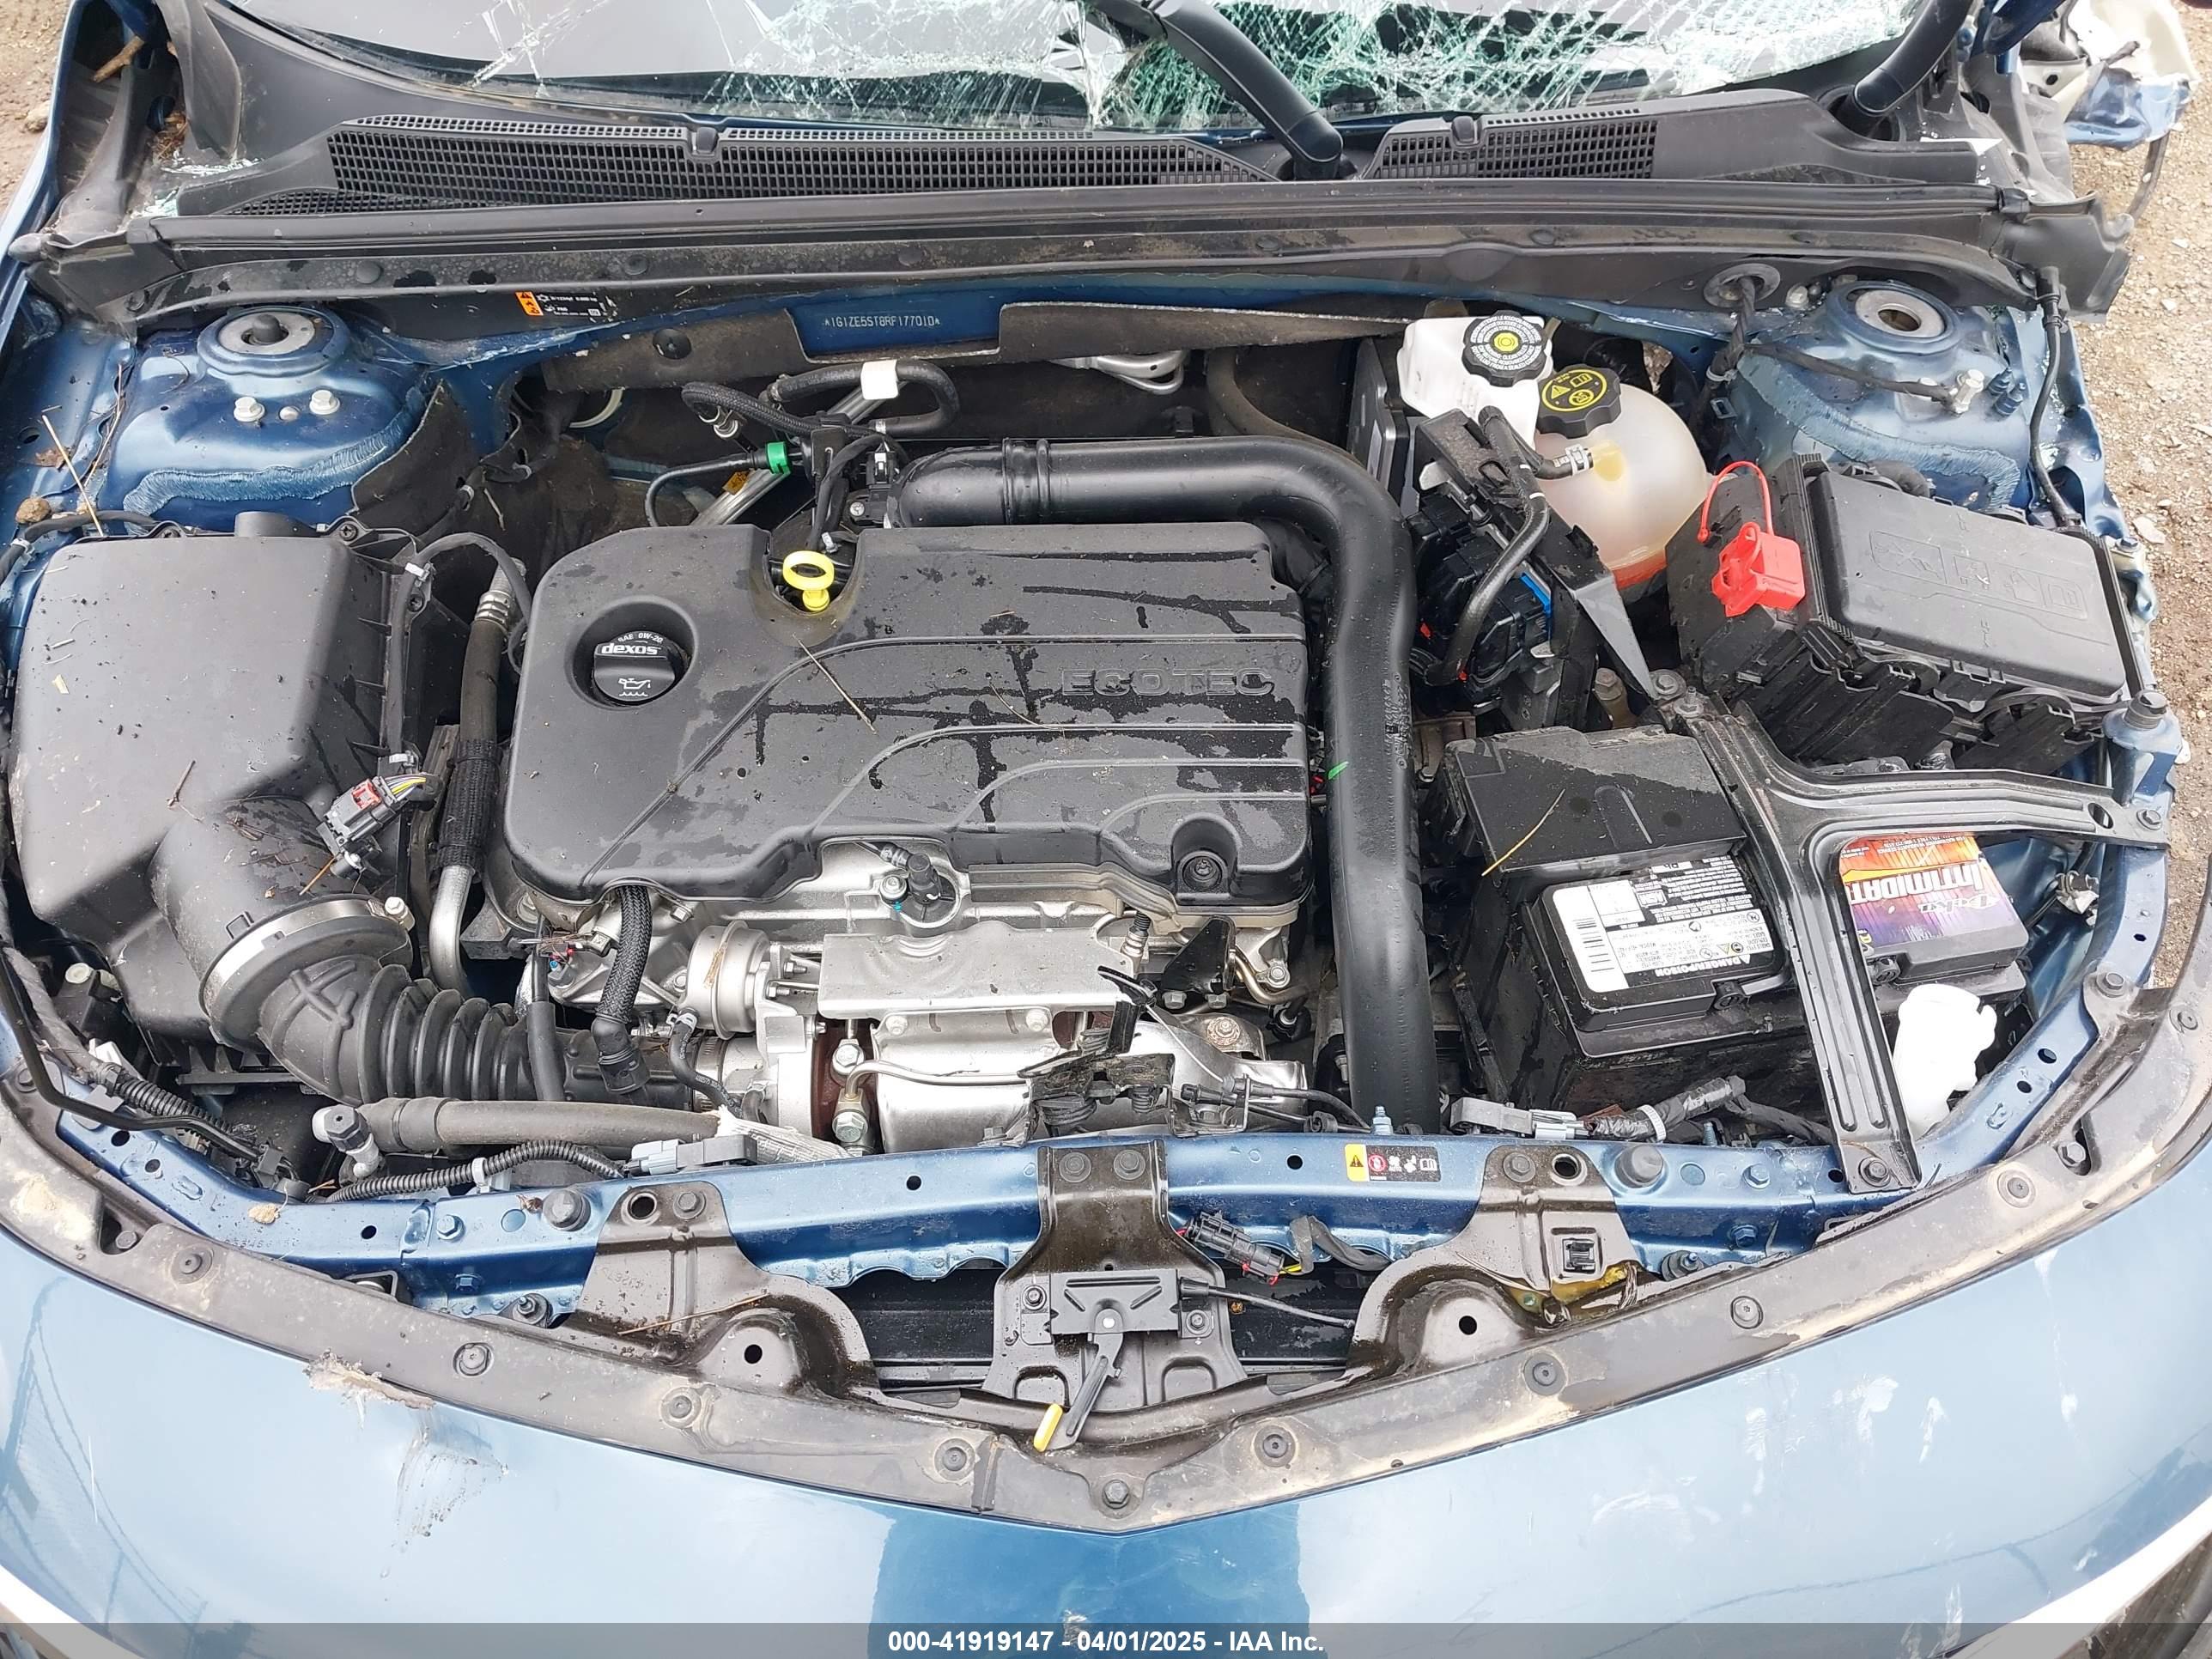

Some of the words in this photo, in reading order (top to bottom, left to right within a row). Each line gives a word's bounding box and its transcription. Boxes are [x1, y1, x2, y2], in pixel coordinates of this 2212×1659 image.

[617, 633, 635, 642] SAE
[601, 643, 658, 655] dexos
[1062, 668, 1275, 696] ECOTEC
